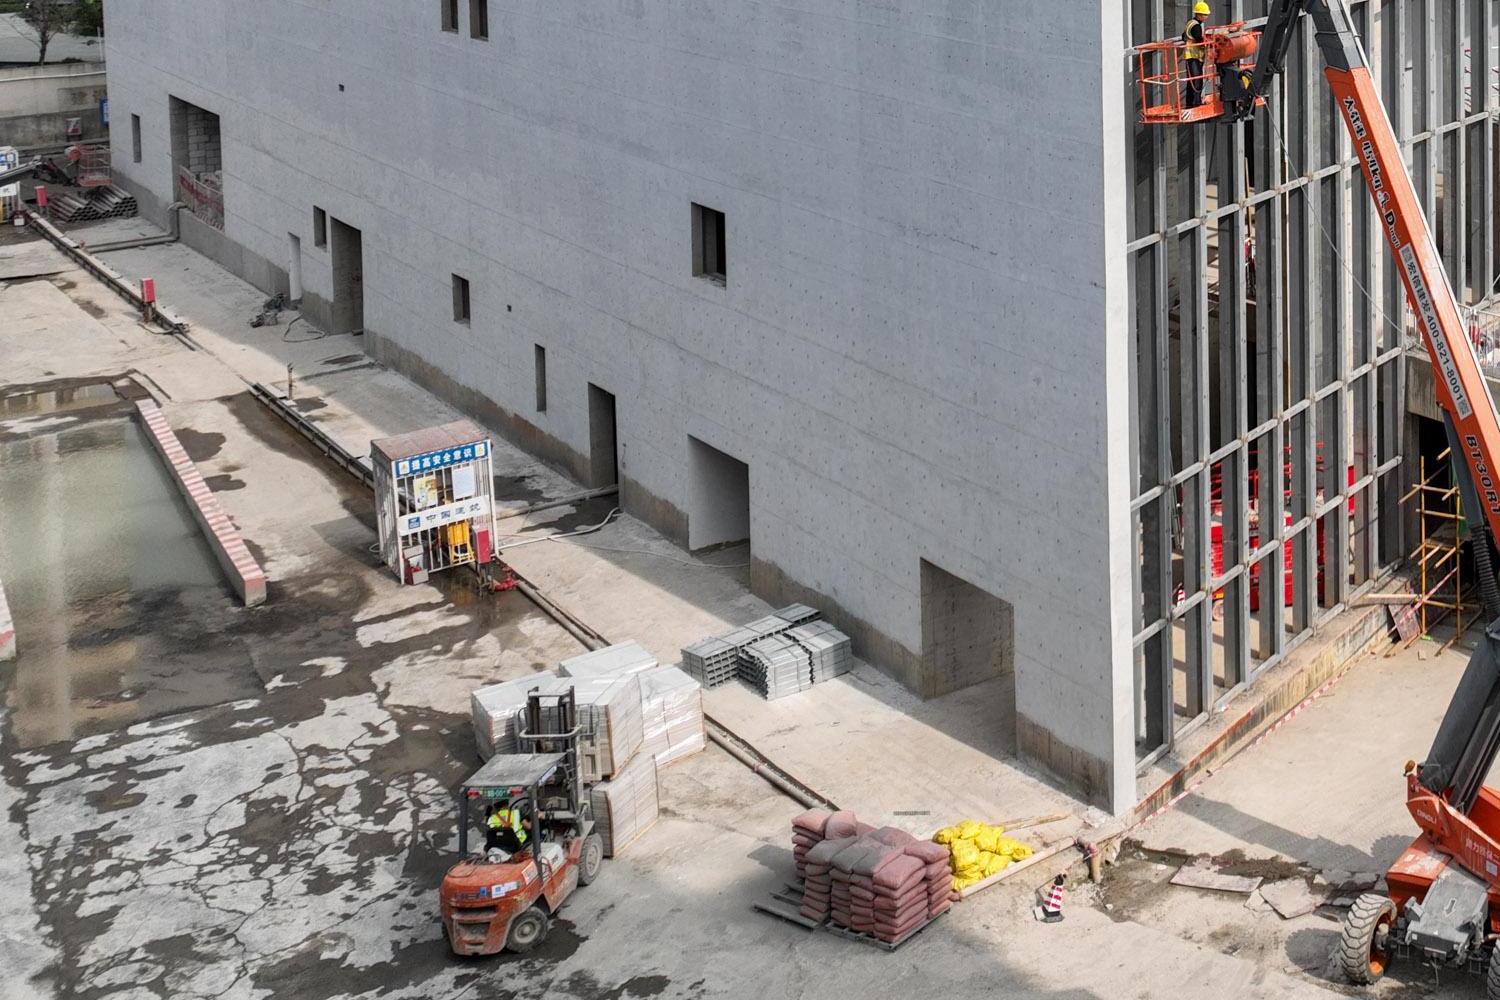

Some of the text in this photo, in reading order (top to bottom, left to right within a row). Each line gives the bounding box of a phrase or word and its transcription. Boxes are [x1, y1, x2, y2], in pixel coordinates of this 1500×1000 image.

[1407, 262, 1463, 401] 宏信建发 400-821-8001
[411, 447, 473, 471] 提高安全意识
